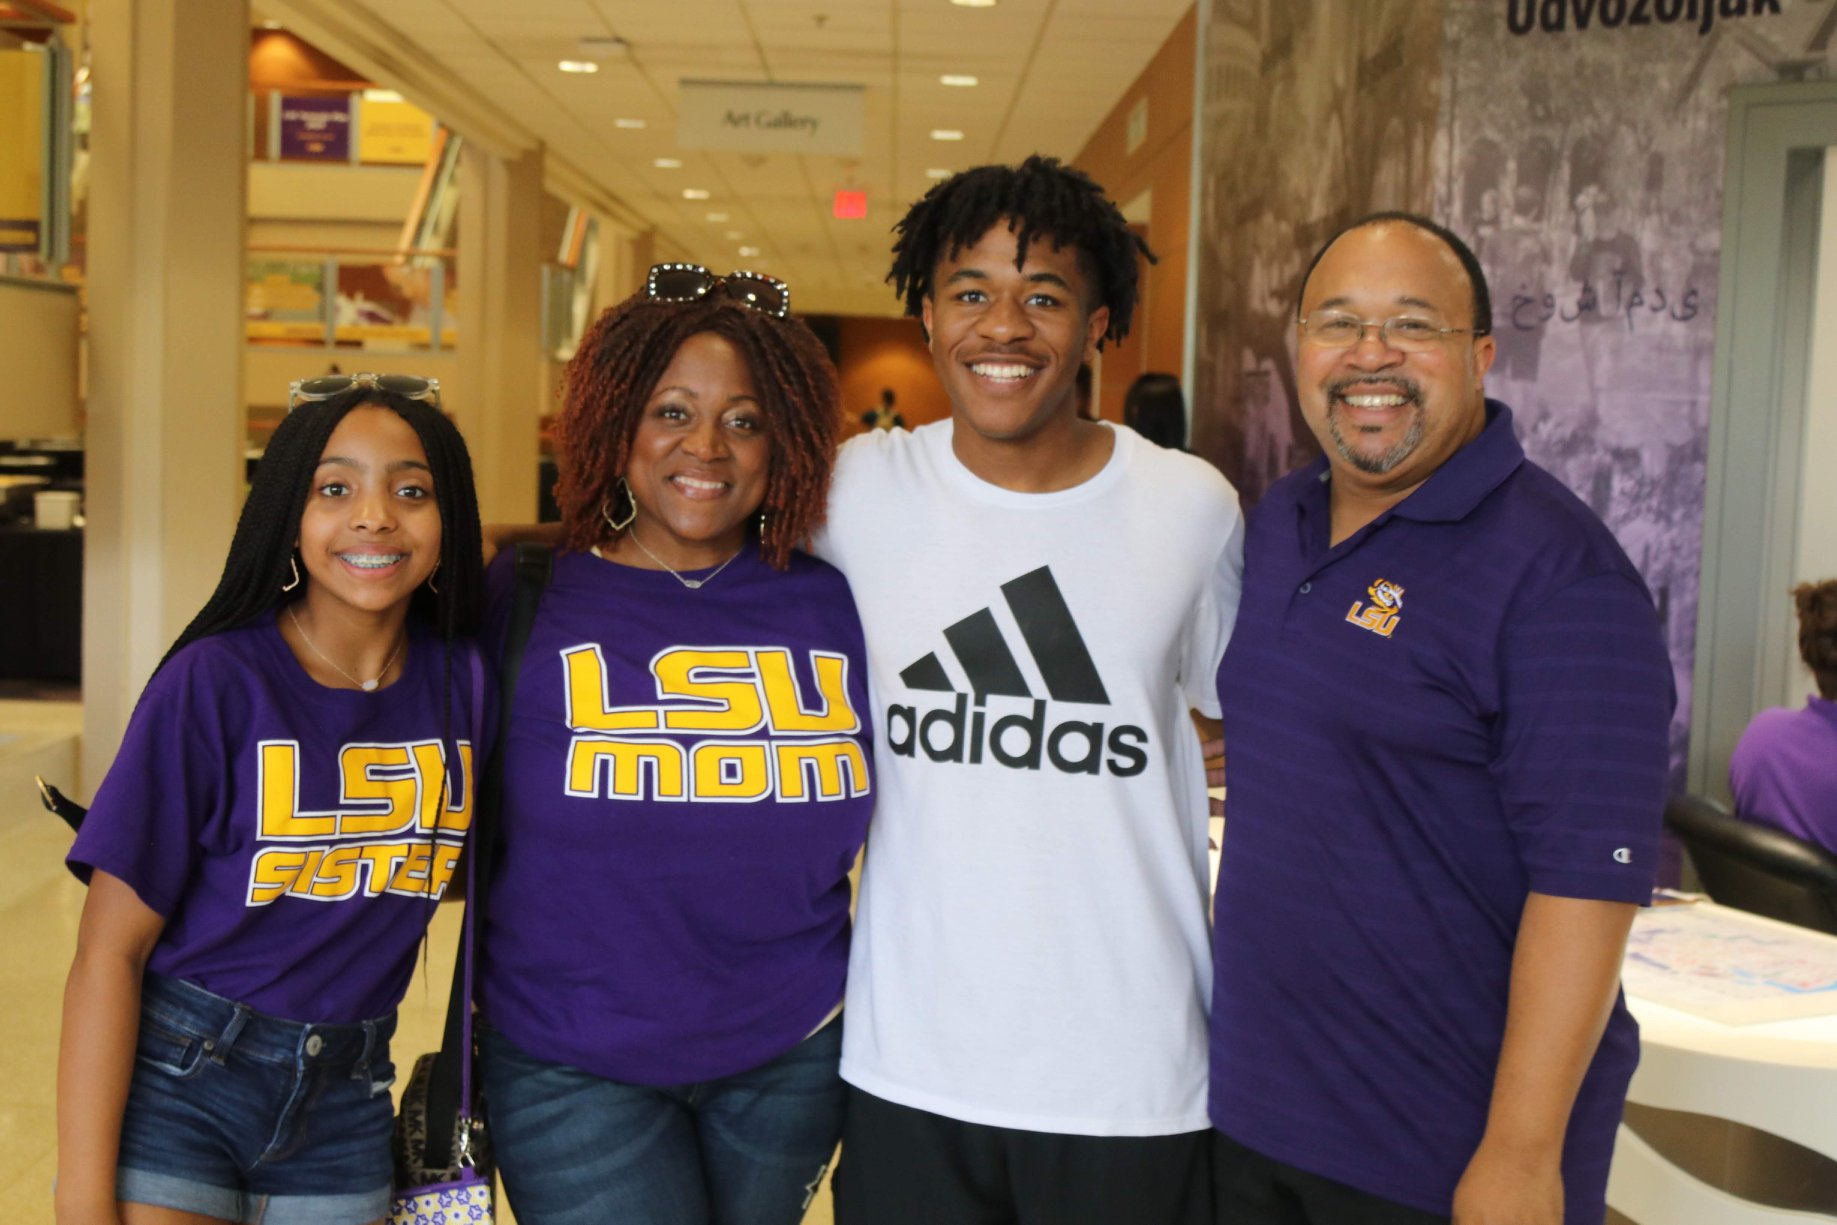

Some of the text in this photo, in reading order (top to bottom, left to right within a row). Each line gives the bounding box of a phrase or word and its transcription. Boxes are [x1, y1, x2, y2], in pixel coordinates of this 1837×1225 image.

[722, 110, 820, 138] Art Gallery
[1345, 601, 1401, 636] LSU
[560, 643, 861, 735] LSU
[887, 692, 1149, 778] adidas
[256, 738, 473, 841] LSU
